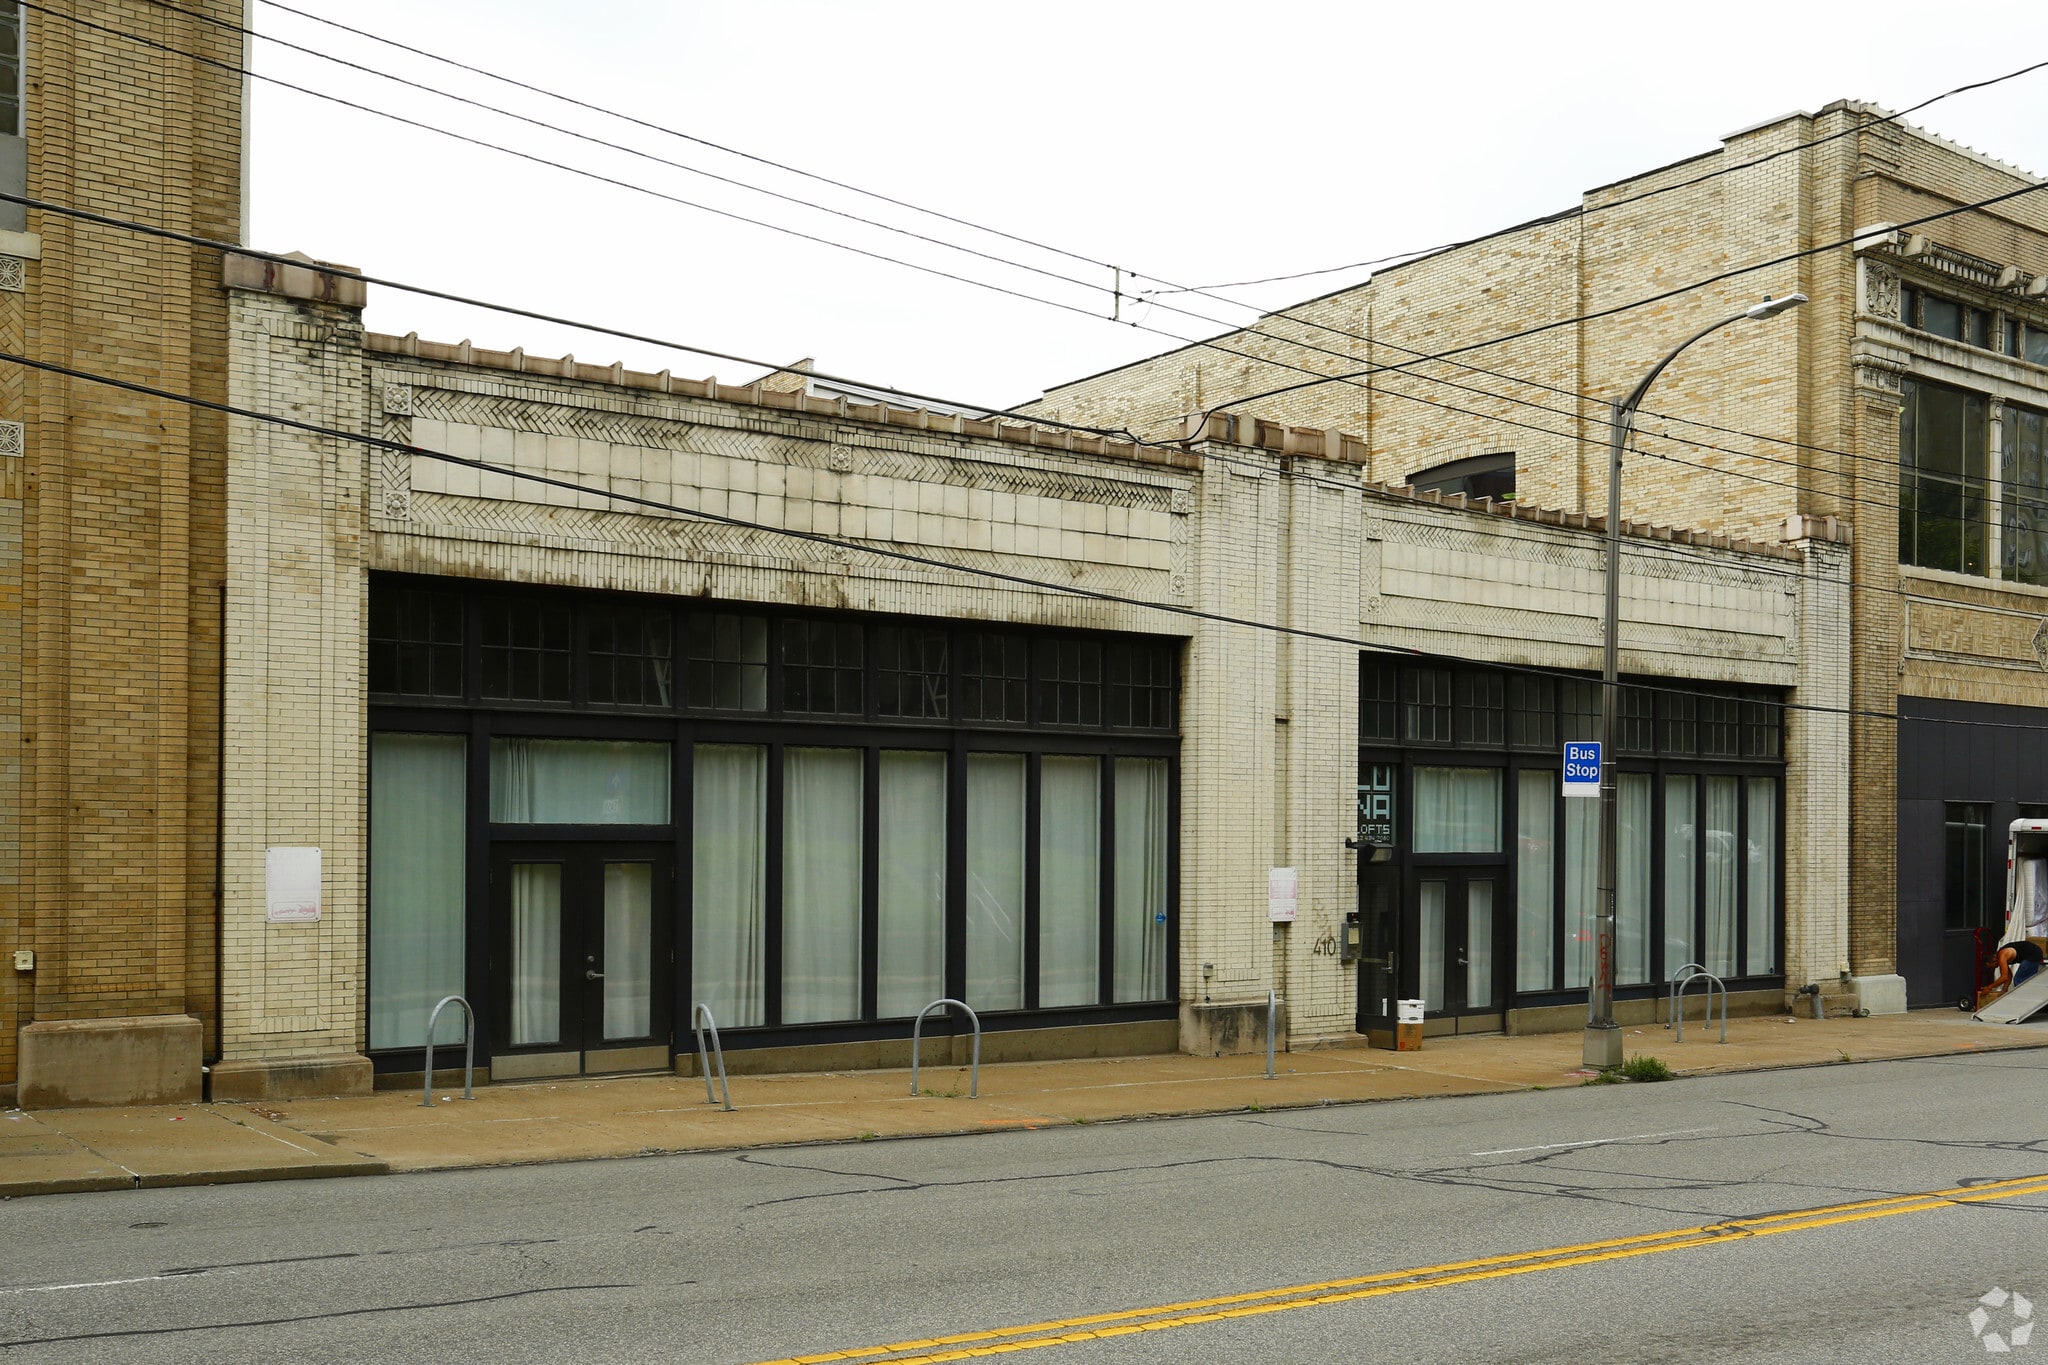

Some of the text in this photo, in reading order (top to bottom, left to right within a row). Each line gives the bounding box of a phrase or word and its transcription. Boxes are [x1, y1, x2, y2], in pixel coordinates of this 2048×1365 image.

[1570, 747, 1595, 760] Bus
[1566, 763, 1598, 779] Stop
[1357, 824, 1391, 835] OFTS
[1313, 937, 1336, 956] 410
